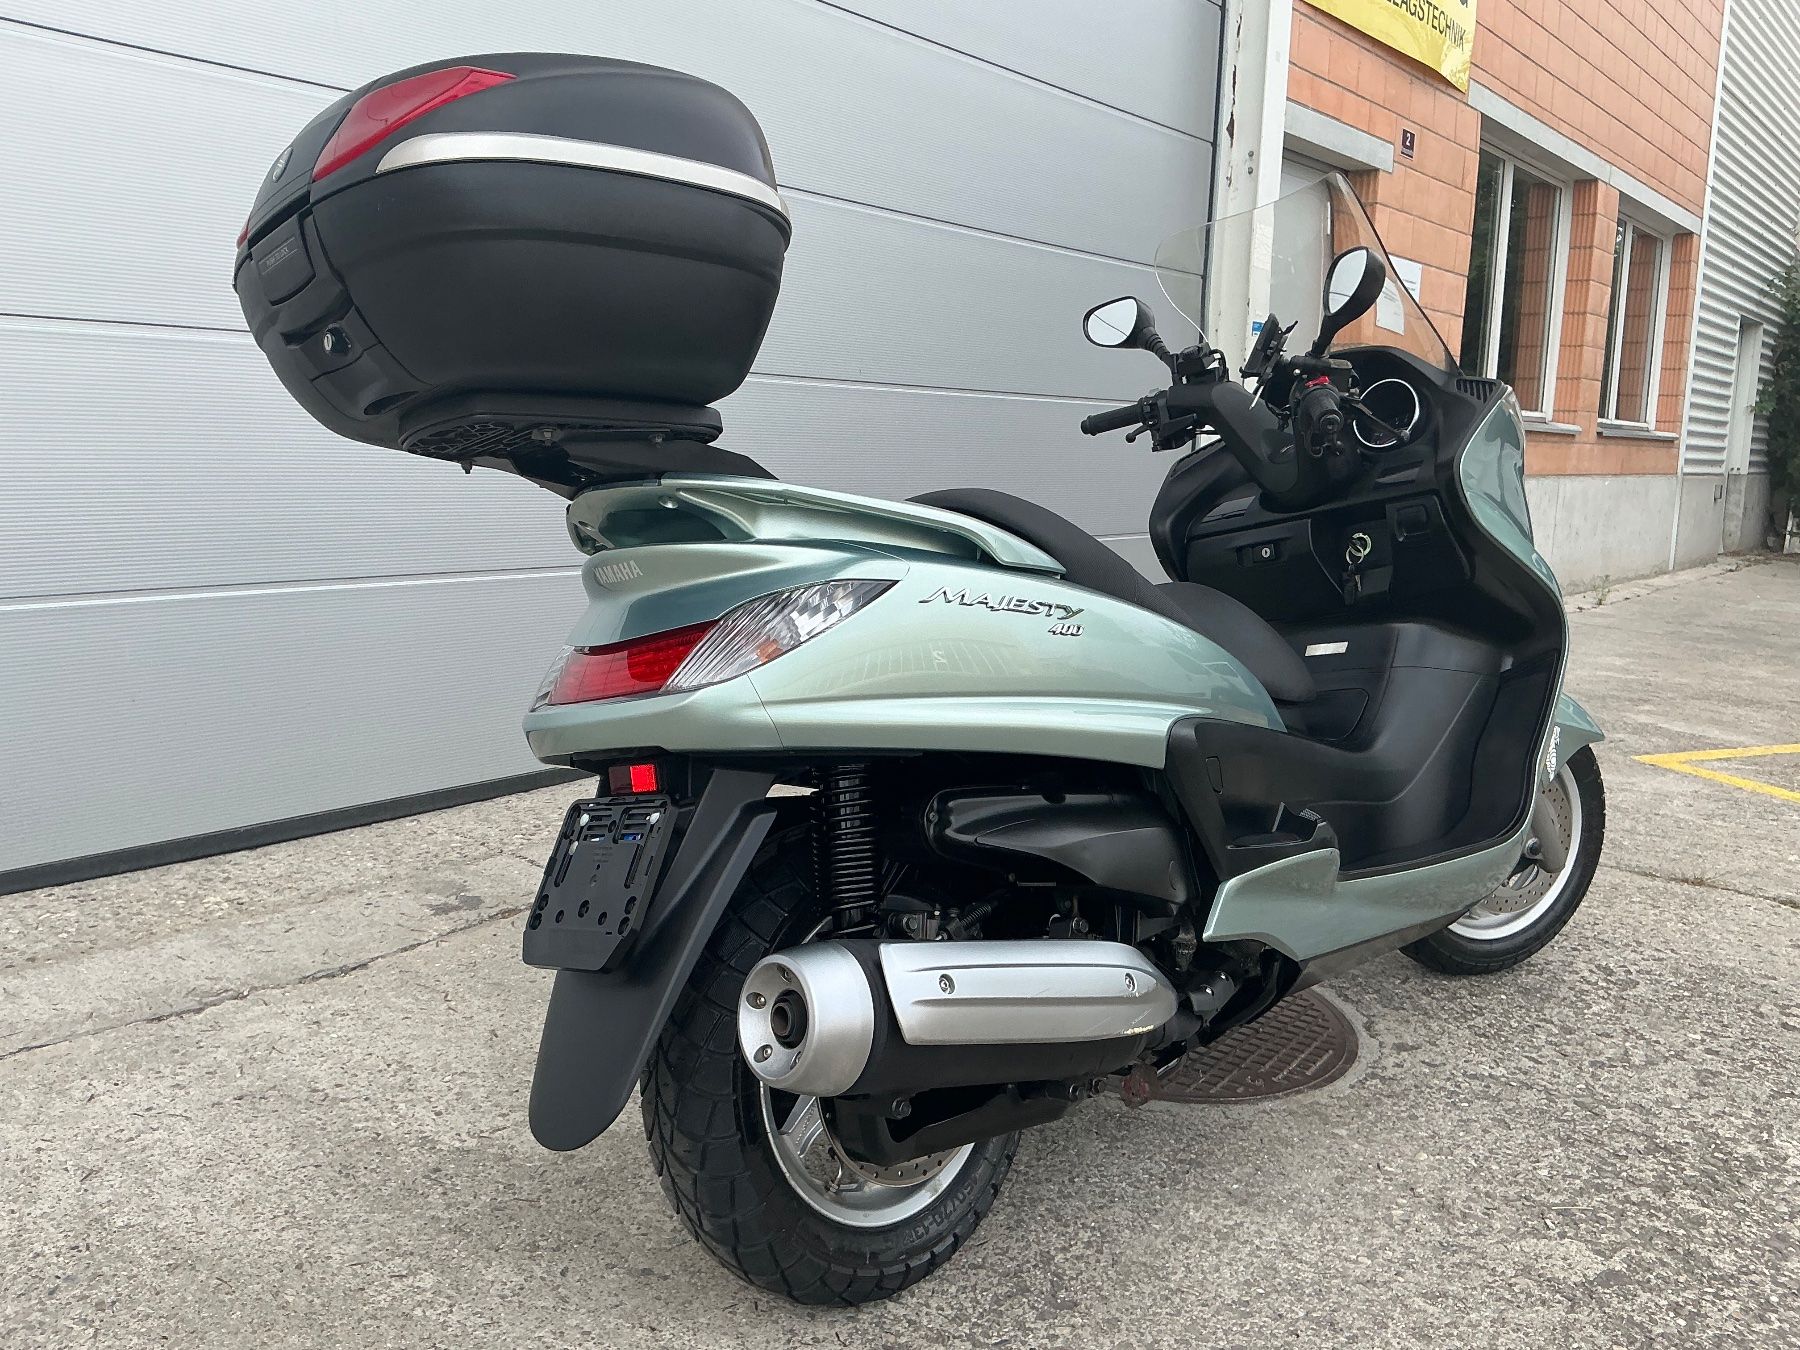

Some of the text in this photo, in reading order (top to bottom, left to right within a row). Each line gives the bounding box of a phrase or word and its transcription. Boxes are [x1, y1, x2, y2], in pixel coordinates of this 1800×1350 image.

[1406, 132, 1411, 146] 2
[592, 560, 643, 584] YAMAHA
[918, 586, 1085, 620] MAJESTY
[1048, 622, 1085, 637] 400
